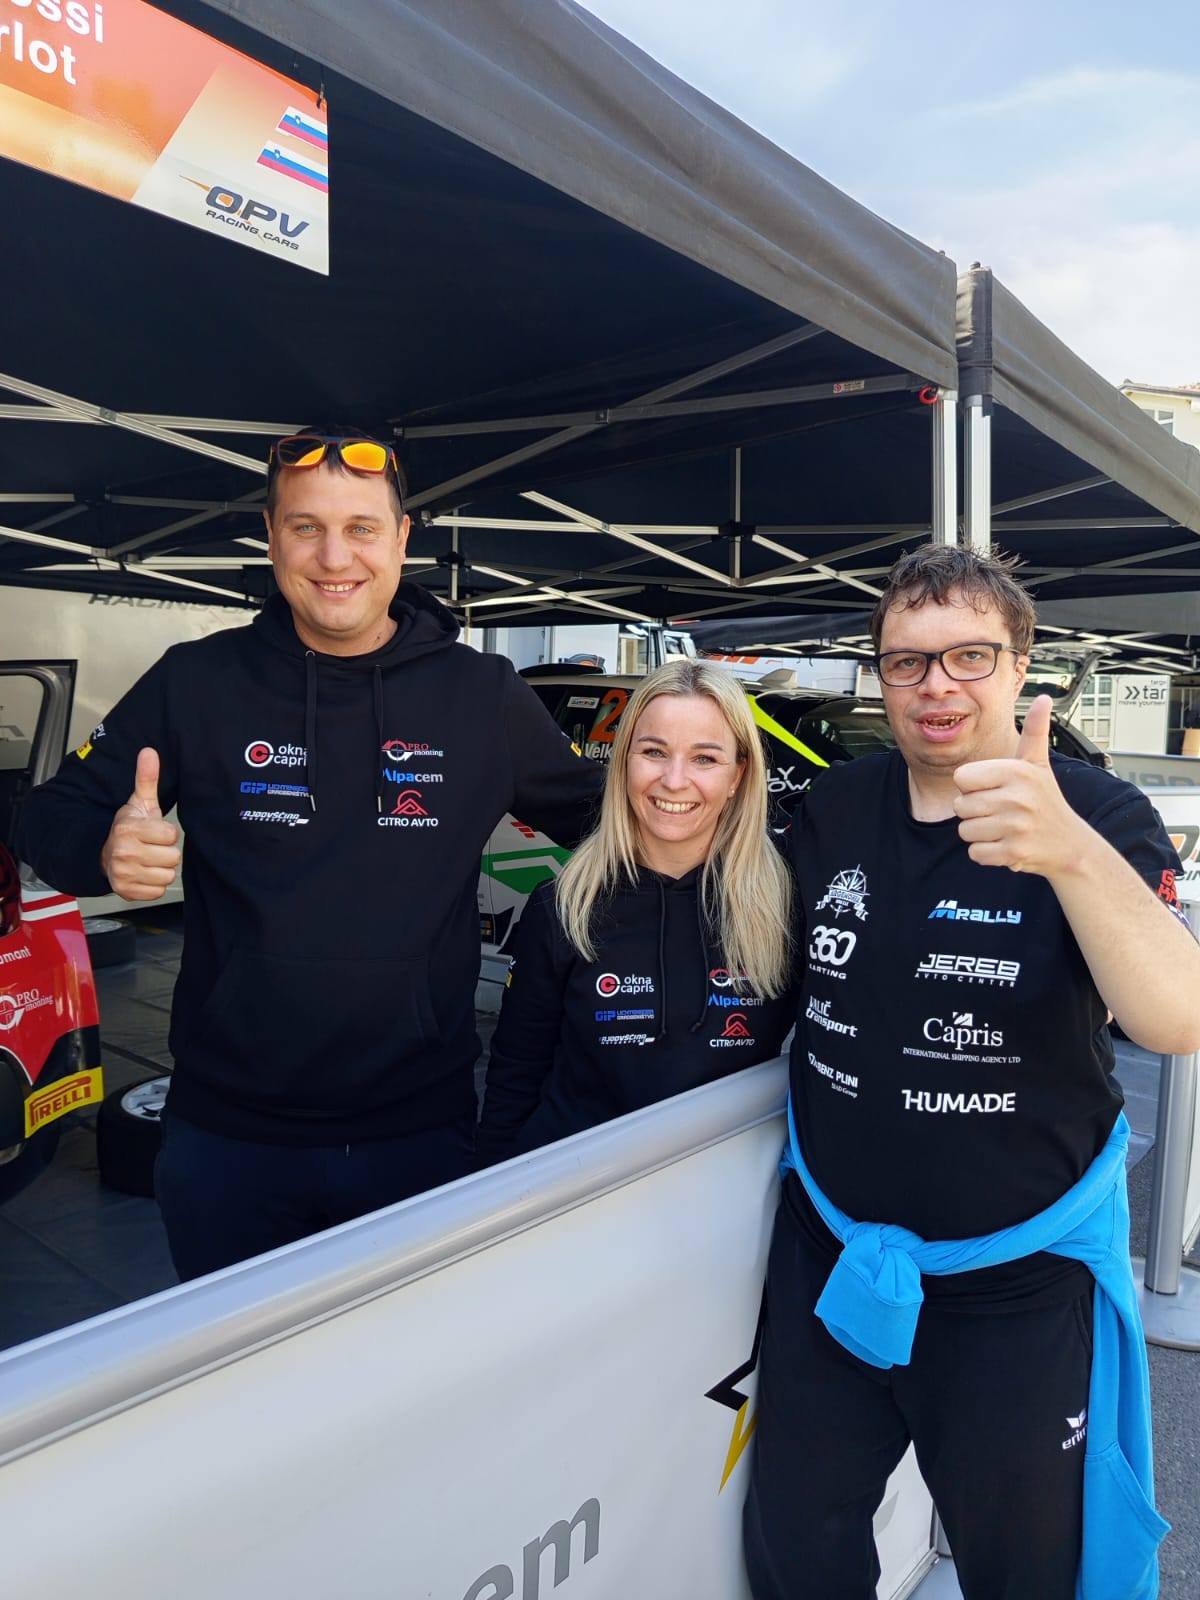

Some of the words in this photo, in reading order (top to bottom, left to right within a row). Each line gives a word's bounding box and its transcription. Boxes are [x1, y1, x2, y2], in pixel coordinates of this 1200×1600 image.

[11, 0, 104, 43] ssi
[205, 185, 310, 238] OPV
[206, 209, 259, 235] RACING
[263, 232, 299, 250] CARS
[273, 755, 307, 767] capri
[377, 817, 409, 827] CITRO
[411, 817, 439, 827] AVTO
[919, 953, 1020, 977] JEREB
[624, 974, 652, 985] okna
[914, 972, 948, 981] AVTO
[957, 976, 1015, 988] CENTER
[16, 988, 40, 1006] PRO
[620, 984, 655, 995] capris
[805, 1007, 858, 1038] transport
[923, 1017, 1004, 1050] Capris
[709, 1038, 735, 1048] CITRO
[902, 1047, 951, 1060] INTERNATIONAL
[951, 1053, 980, 1062] SHIPPING
[836, 1070, 858, 1088] PLINI
[30, 1076, 92, 1127] PIRELLI
